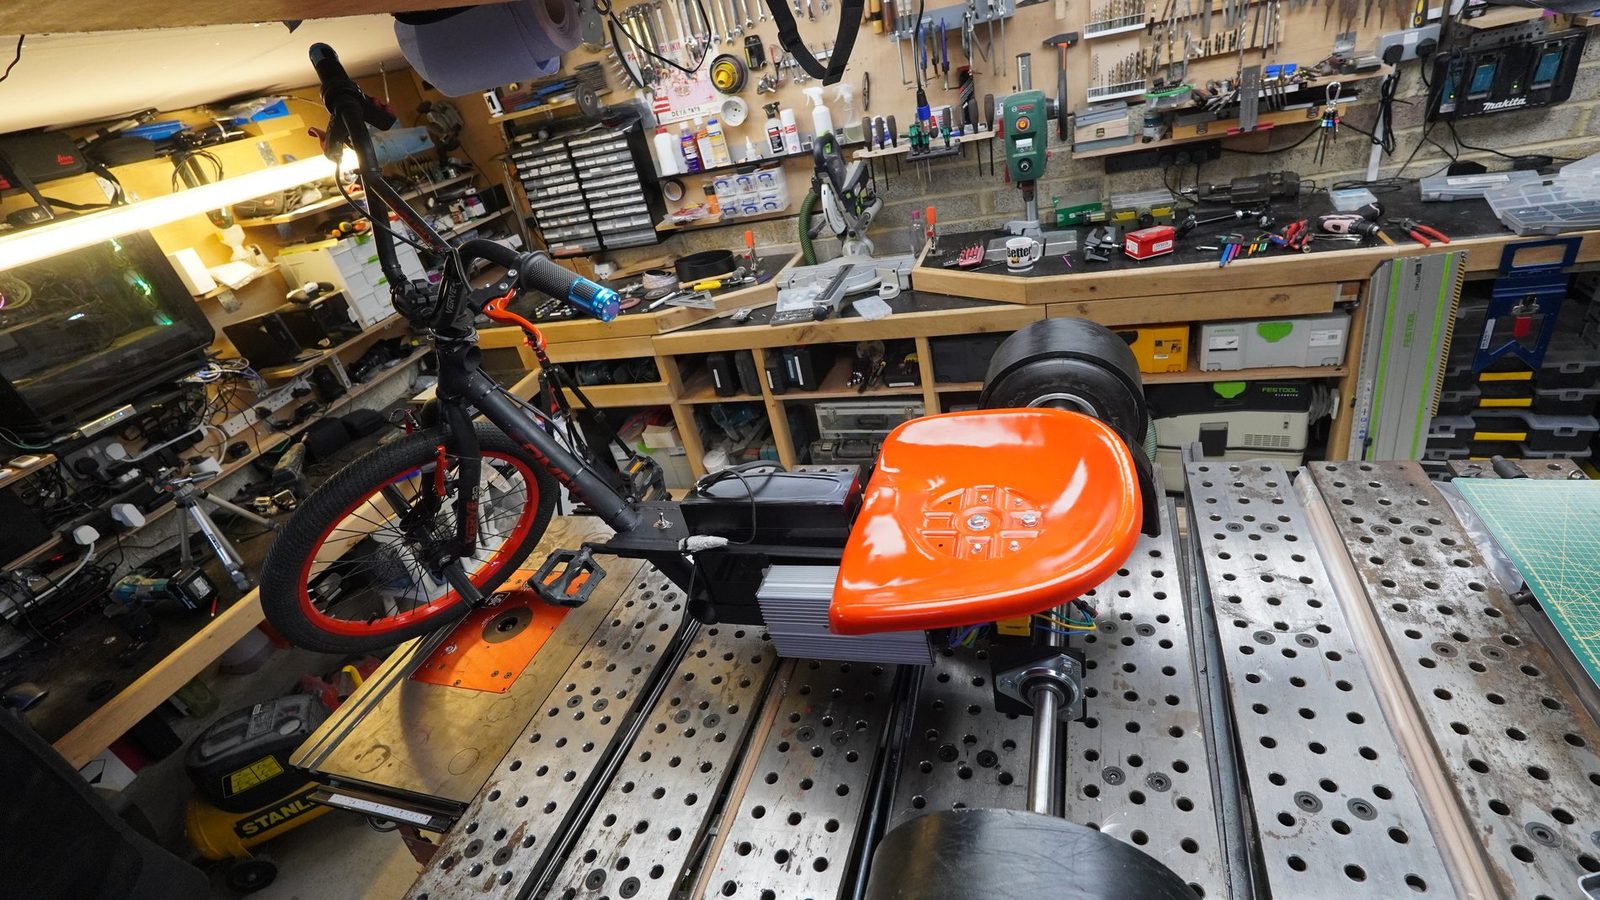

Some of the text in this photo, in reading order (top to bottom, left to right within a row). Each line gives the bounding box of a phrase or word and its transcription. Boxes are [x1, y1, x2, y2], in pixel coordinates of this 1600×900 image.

[1483, 97, 1526, 110] Makita
[1007, 244, 1033, 258] Better
[445, 285, 457, 314] VERVE
